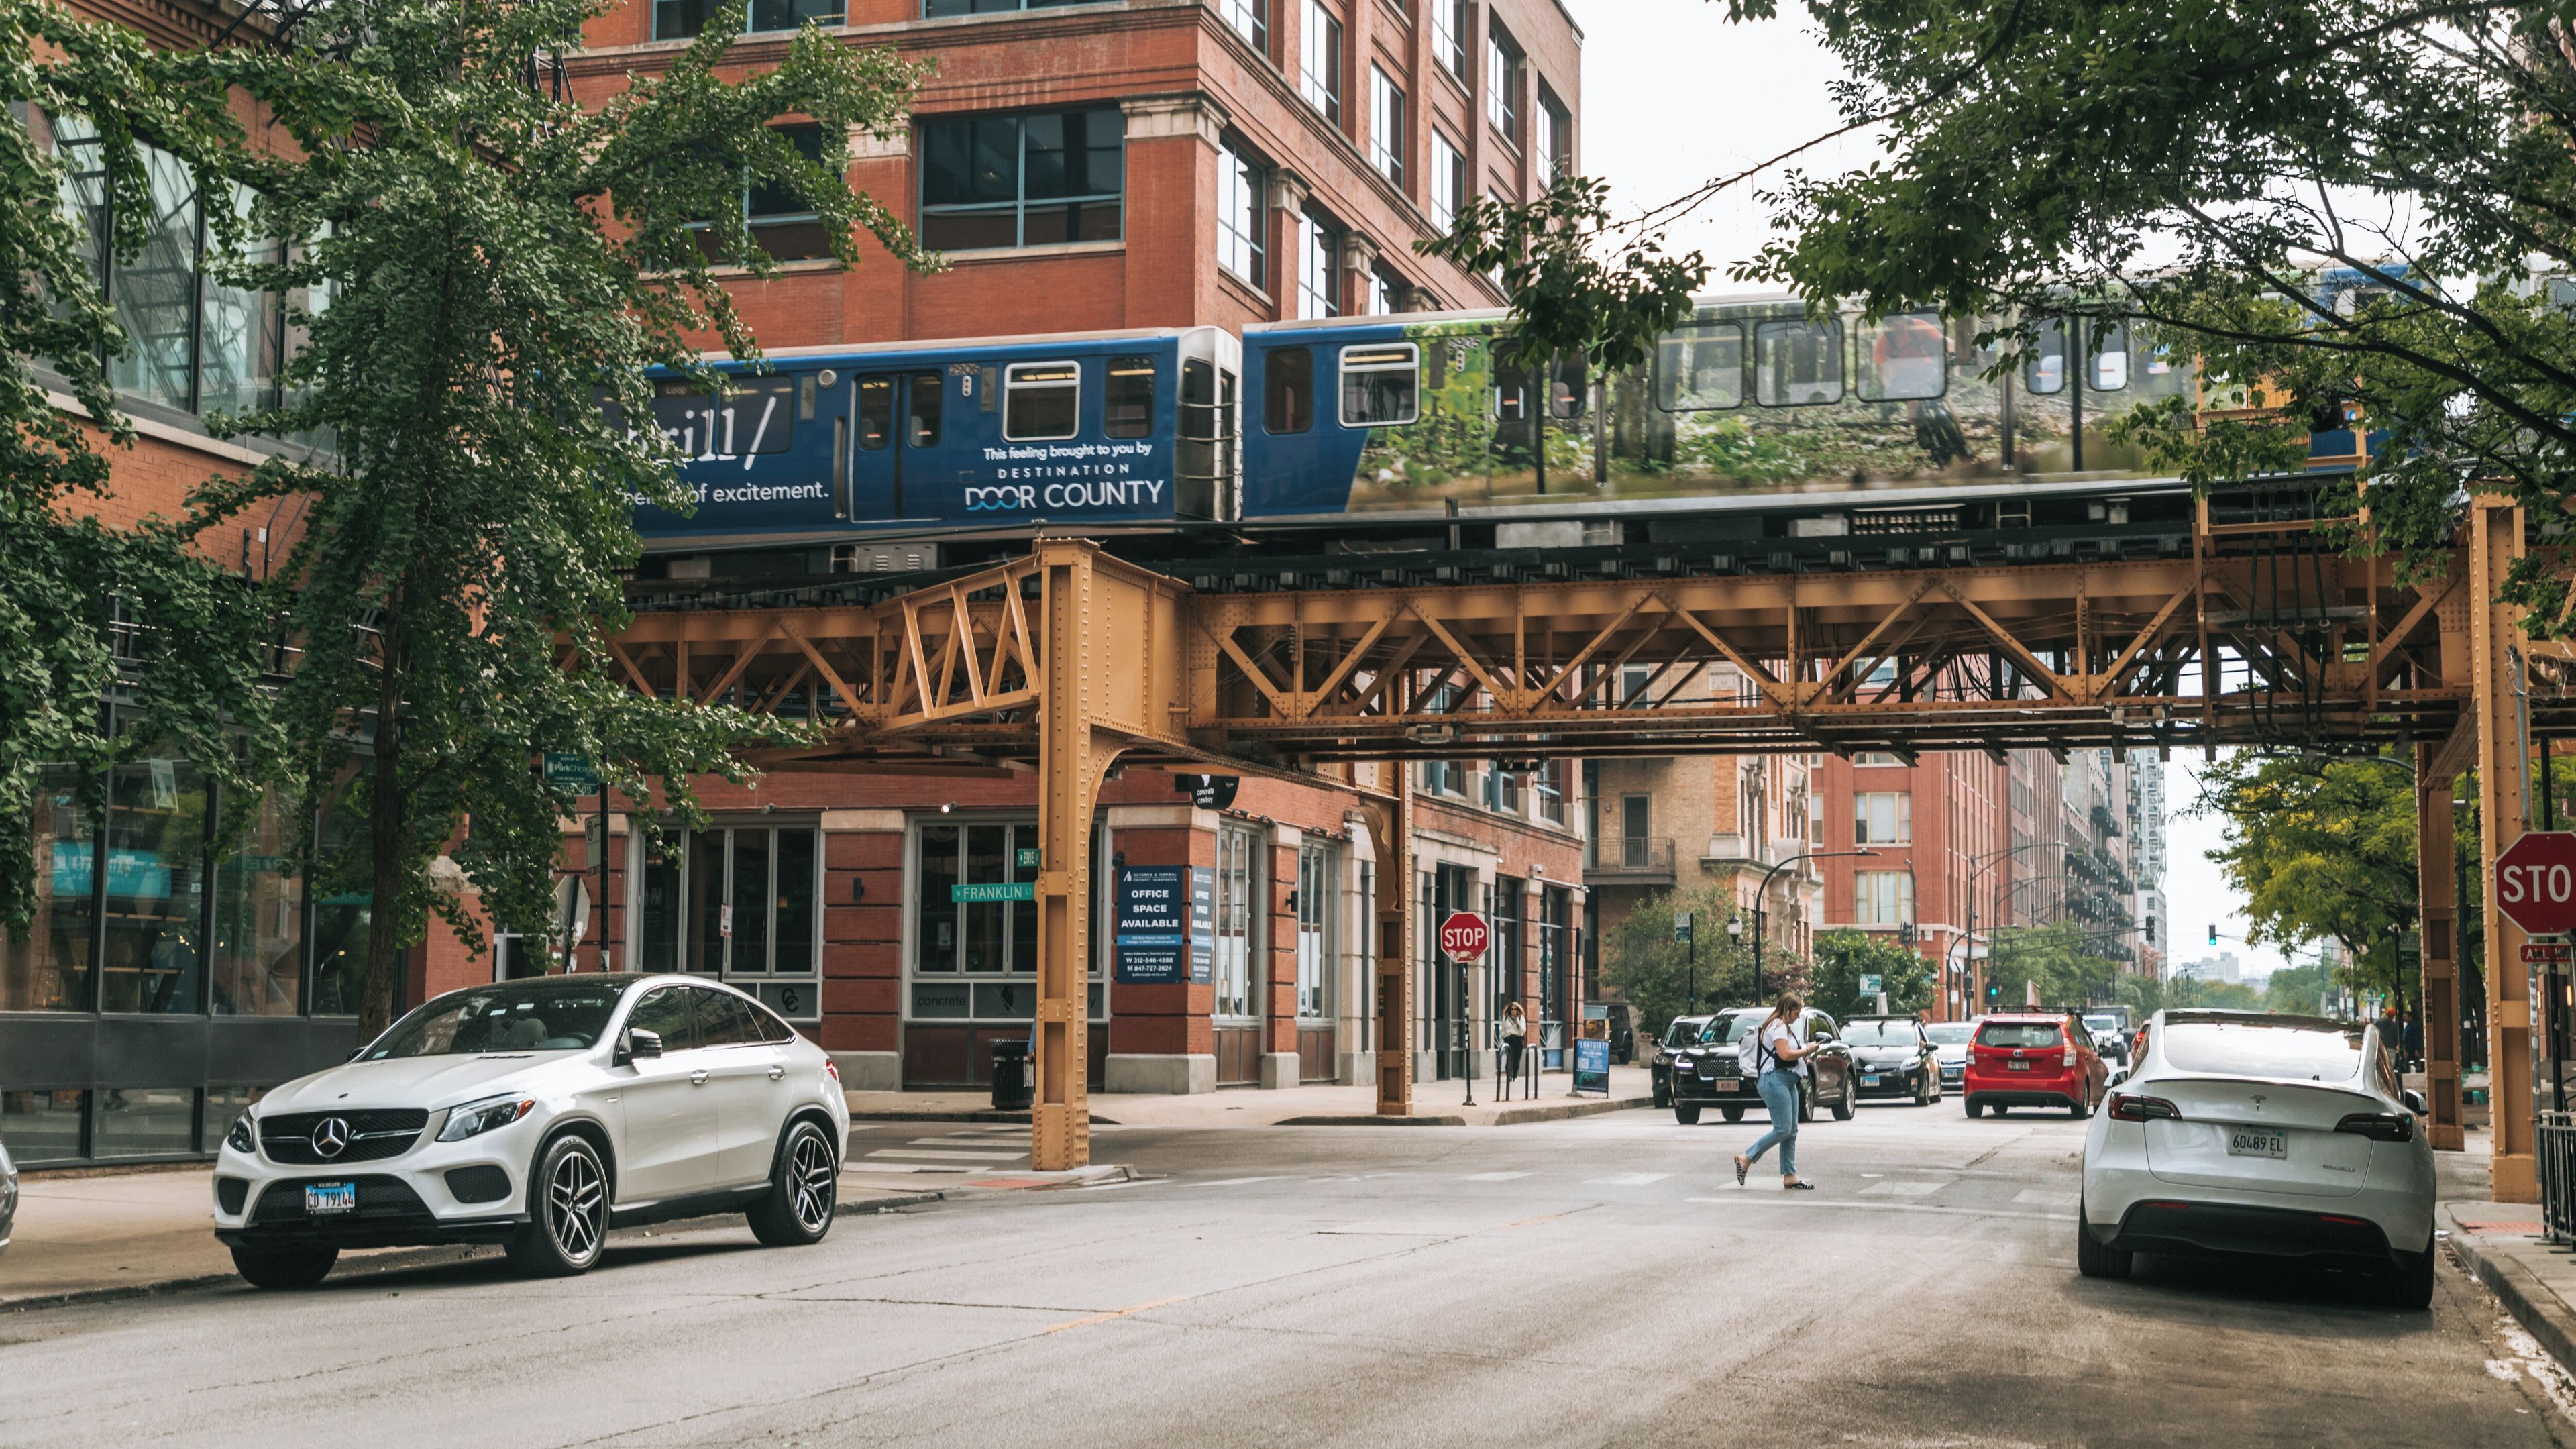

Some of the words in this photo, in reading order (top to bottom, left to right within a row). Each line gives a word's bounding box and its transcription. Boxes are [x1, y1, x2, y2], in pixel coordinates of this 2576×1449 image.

[983, 447, 1007, 460] This
[1008, 446, 1047, 461] feeling
[1049, 443, 1095, 459] brought
[1097, 444, 1110, 455] to
[1111, 445, 1135, 458] you
[1136, 441, 1152, 457] by
[998, 463, 1130, 480] DESTINATION
[688, 482, 708, 504] of
[712, 481, 829, 502] excitement.
[1044, 480, 1165, 508] COUNTY
[555, 765, 593, 774] ParkChicag
[1197, 787, 1214, 796] concrete
[1197, 796, 1213, 804] cowboy
[1023, 851, 1035, 865] ERIE
[2502, 864, 2571, 903] STO
[963, 885, 1022, 900] FRANKLIN
[1024, 888, 1032, 896] ST
[1131, 890, 1169, 898] OFFICE
[1132, 904, 1167, 913] SPACE
[1121, 919, 1179, 928] AVAILABLE
[1444, 928, 1485, 947] STOP
[918, 996, 966, 1006] concrete
[2233, 1134, 2267, 1150] 60489
[2270, 1137, 2283, 1152] EL
[307, 1193, 319, 1208] CD
[325, 1191, 354, 1208] 79144
